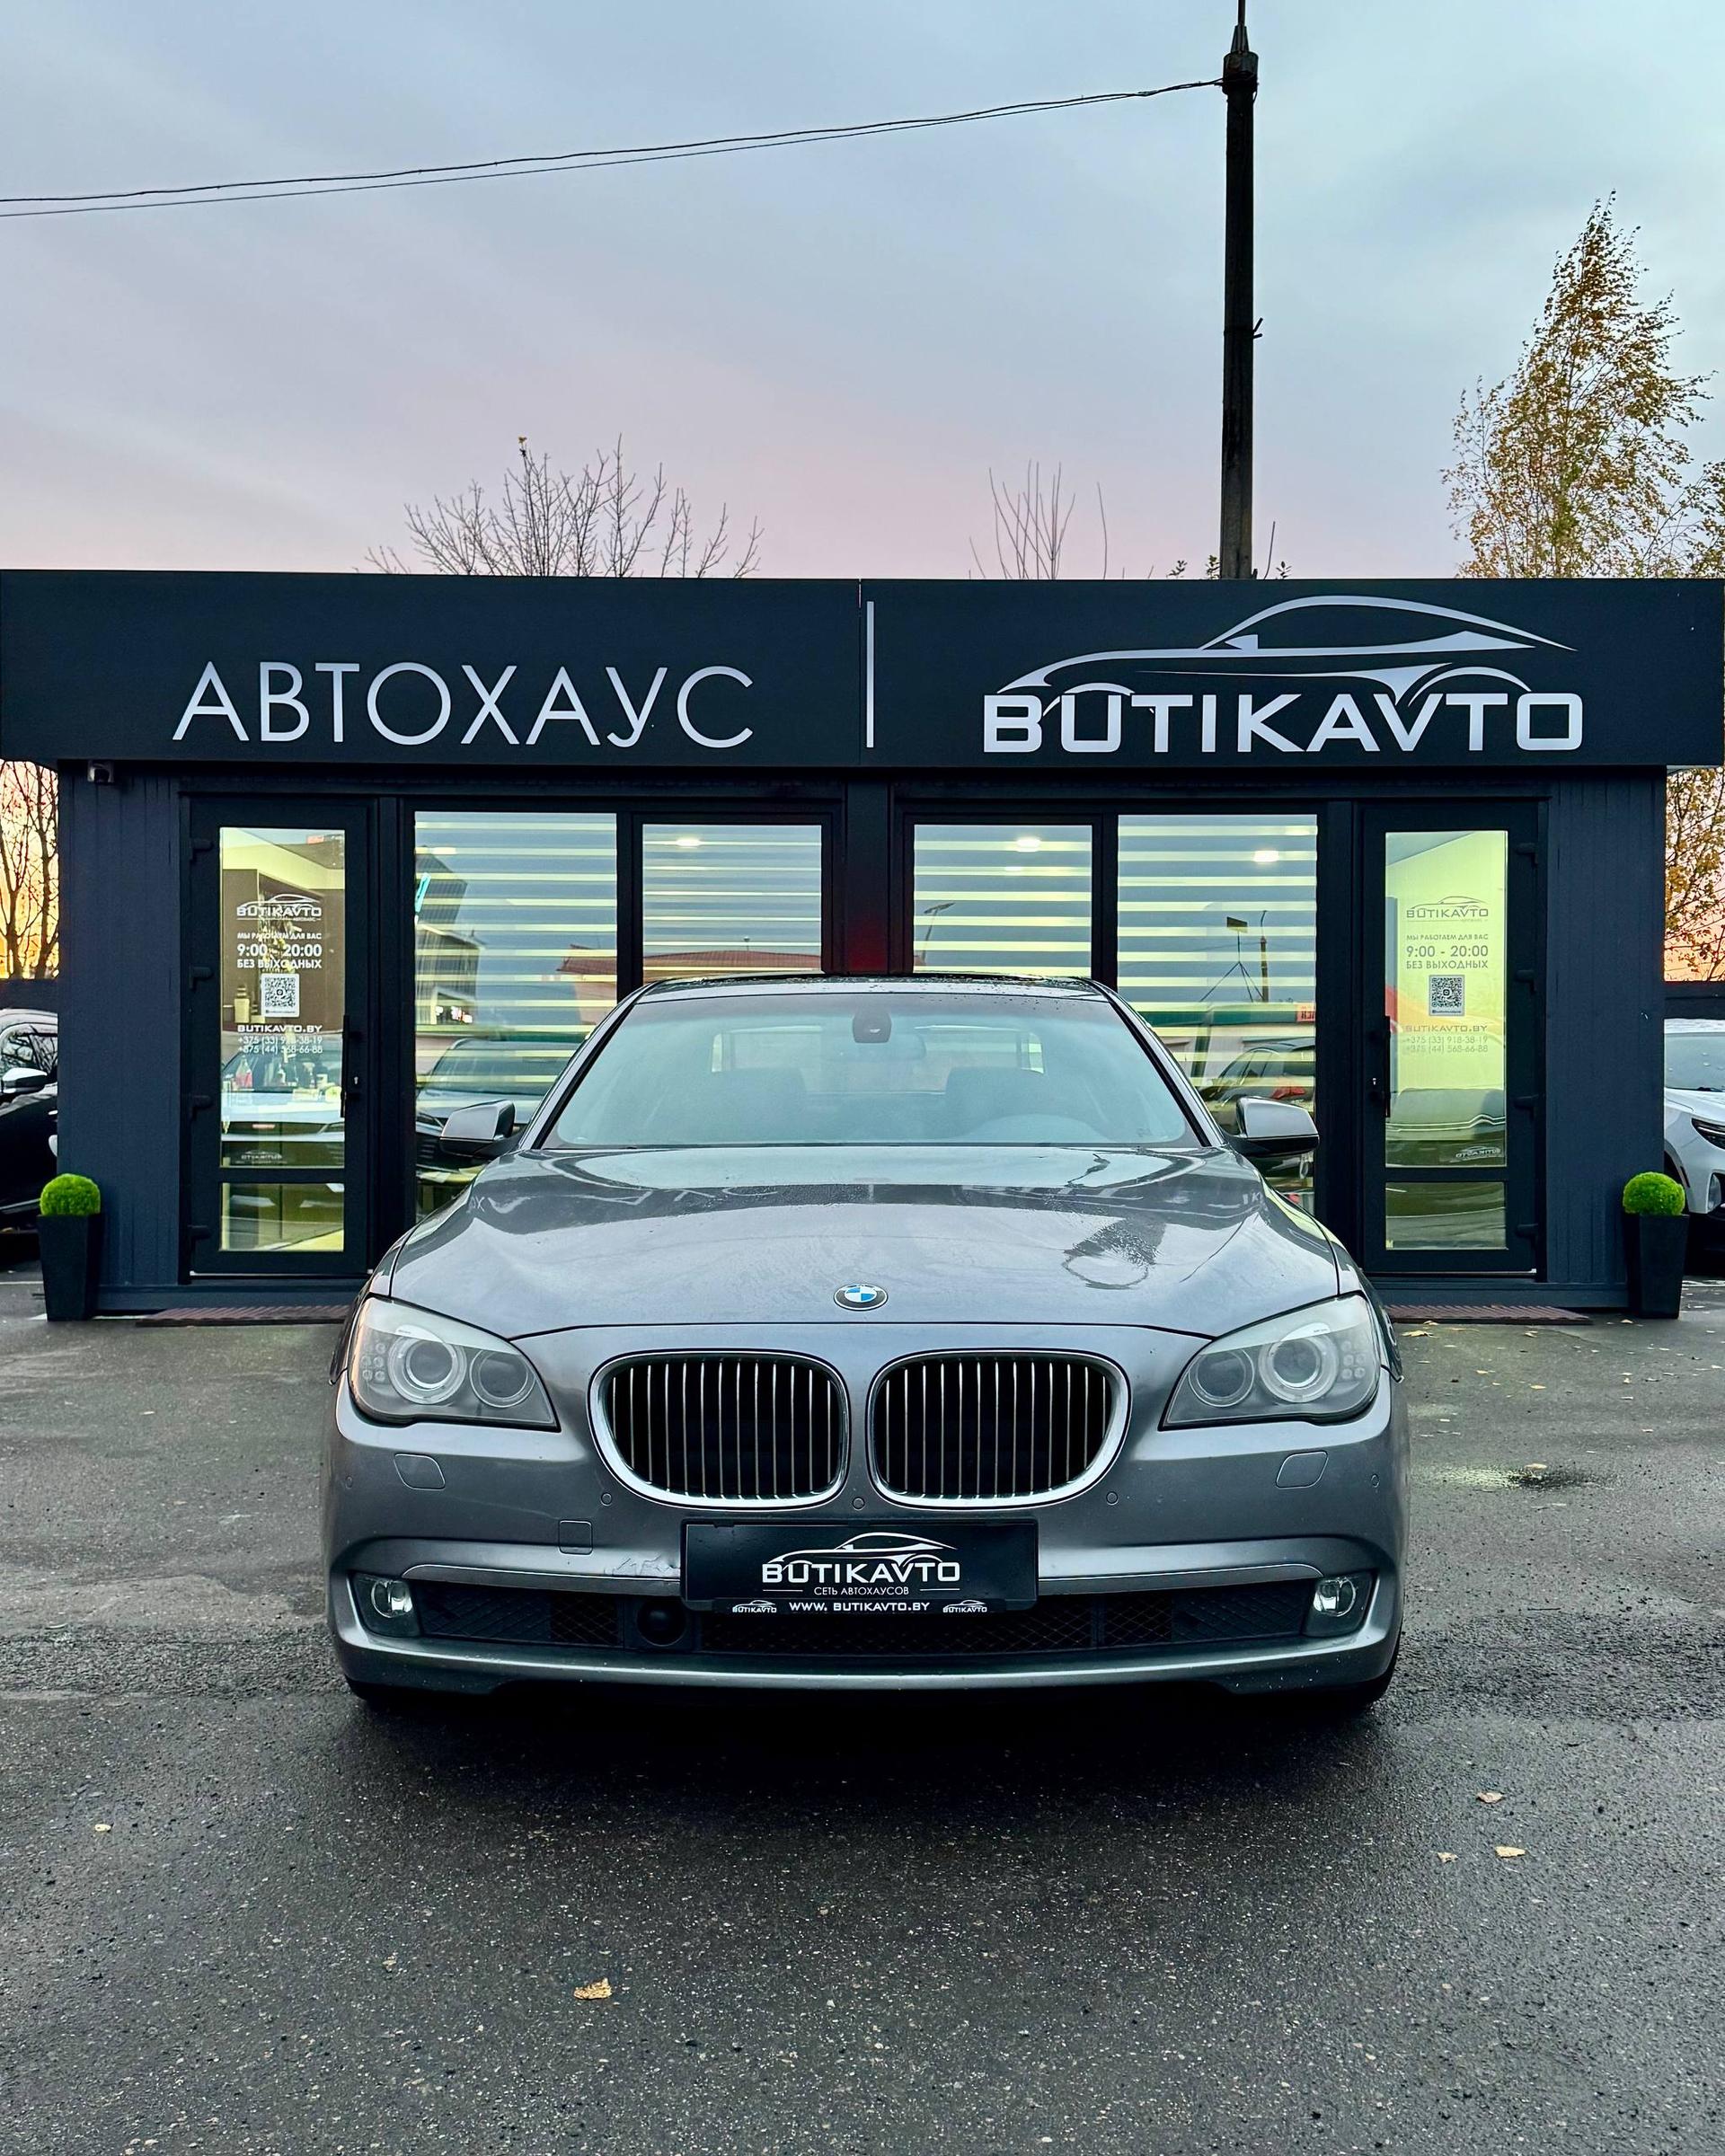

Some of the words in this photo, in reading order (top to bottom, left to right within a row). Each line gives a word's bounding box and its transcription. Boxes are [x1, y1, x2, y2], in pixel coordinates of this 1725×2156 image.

[172, 661, 754, 748] АВТОХАУС
[983, 693, 1584, 753] BUTIKAVTO
[236, 906, 322, 916] BUTIKAVTO
[1406, 908, 1489, 917] BUTIKAVTO
[237, 943, 268, 957] 9:00
[283, 943, 323, 957] 20:00
[1406, 945, 1436, 958] 9:00
[1450, 945, 1489, 957] 20:00
[237, 959, 255, 968] БЕЗ
[258, 959, 322, 969] ВЫХОДНЫХ
[1406, 960, 1423, 969] БЕЗ
[1426, 960, 1489, 969] ВЫХОДНЫХ
[762, 1562, 960, 1583] BUTIKAVTO
[813, 1586, 838, 1595] СЕТЬ
[840, 1586, 910, 1595] АВТОХАУСОВ
[789, 1602, 828, 1612] WWW.
[833, 1602, 931, 1612] BUTIKAVTO.BY
